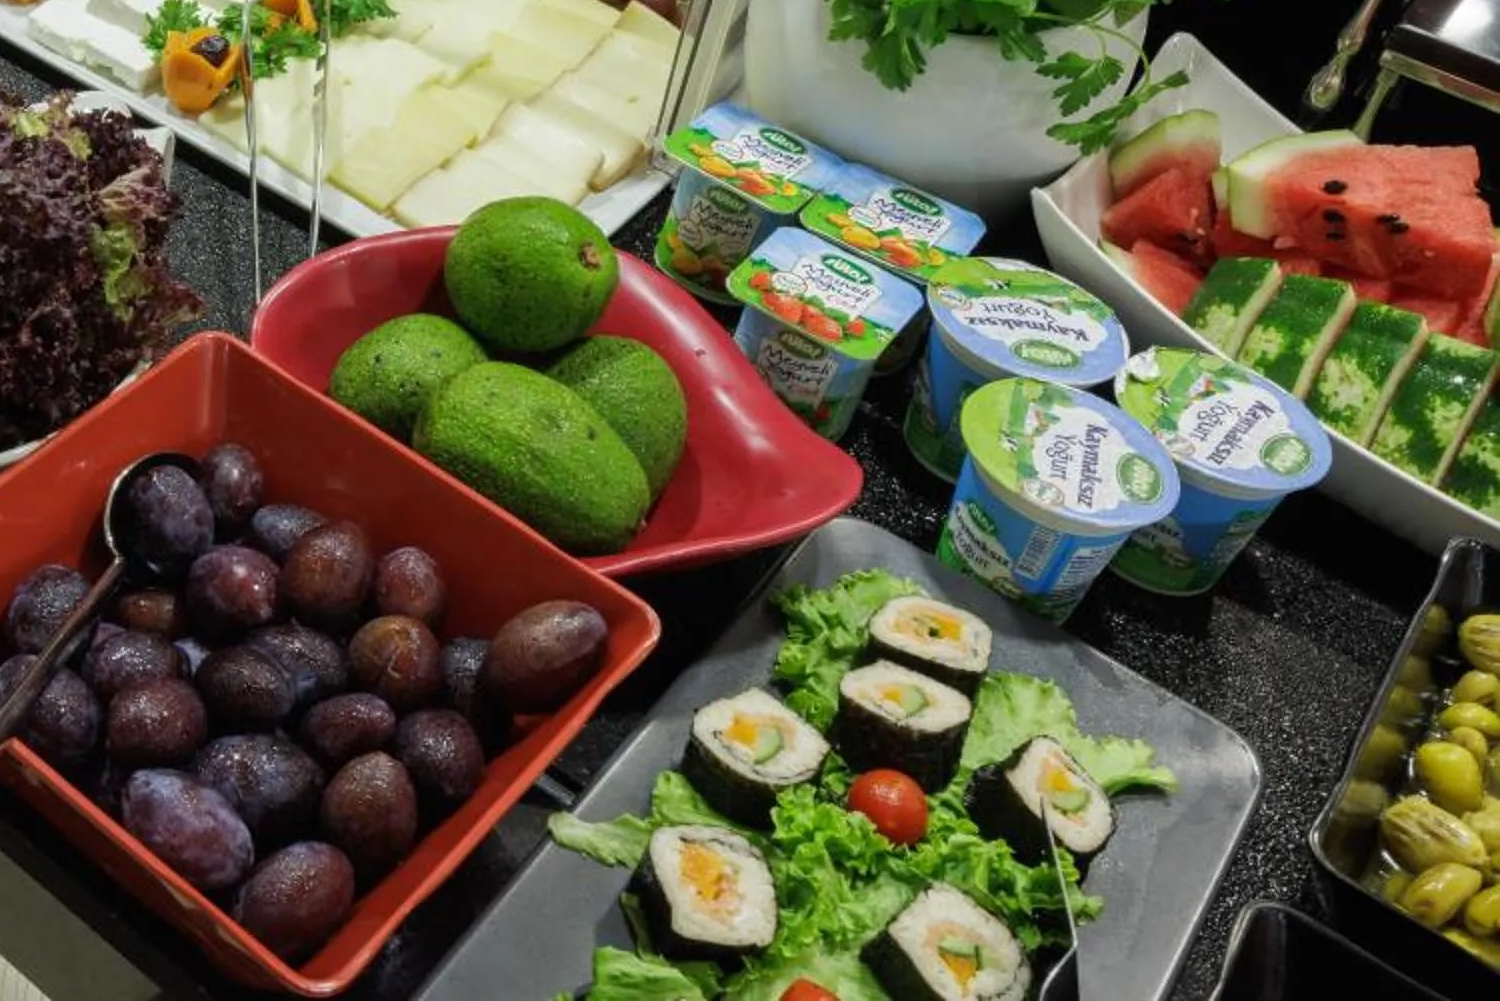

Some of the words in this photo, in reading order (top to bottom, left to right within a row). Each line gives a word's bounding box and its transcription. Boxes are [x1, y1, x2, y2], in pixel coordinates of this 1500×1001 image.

[964, 316, 1089, 342] Kaymaksız
[981, 301, 1057, 323] Yoğurt
[1190, 400, 1238, 442] Yoğurt
[1206, 400, 1276, 466] Kaymaksız
[1046, 434, 1078, 480] Yoğurt
[1077, 423, 1108, 509] Kaymaksız
